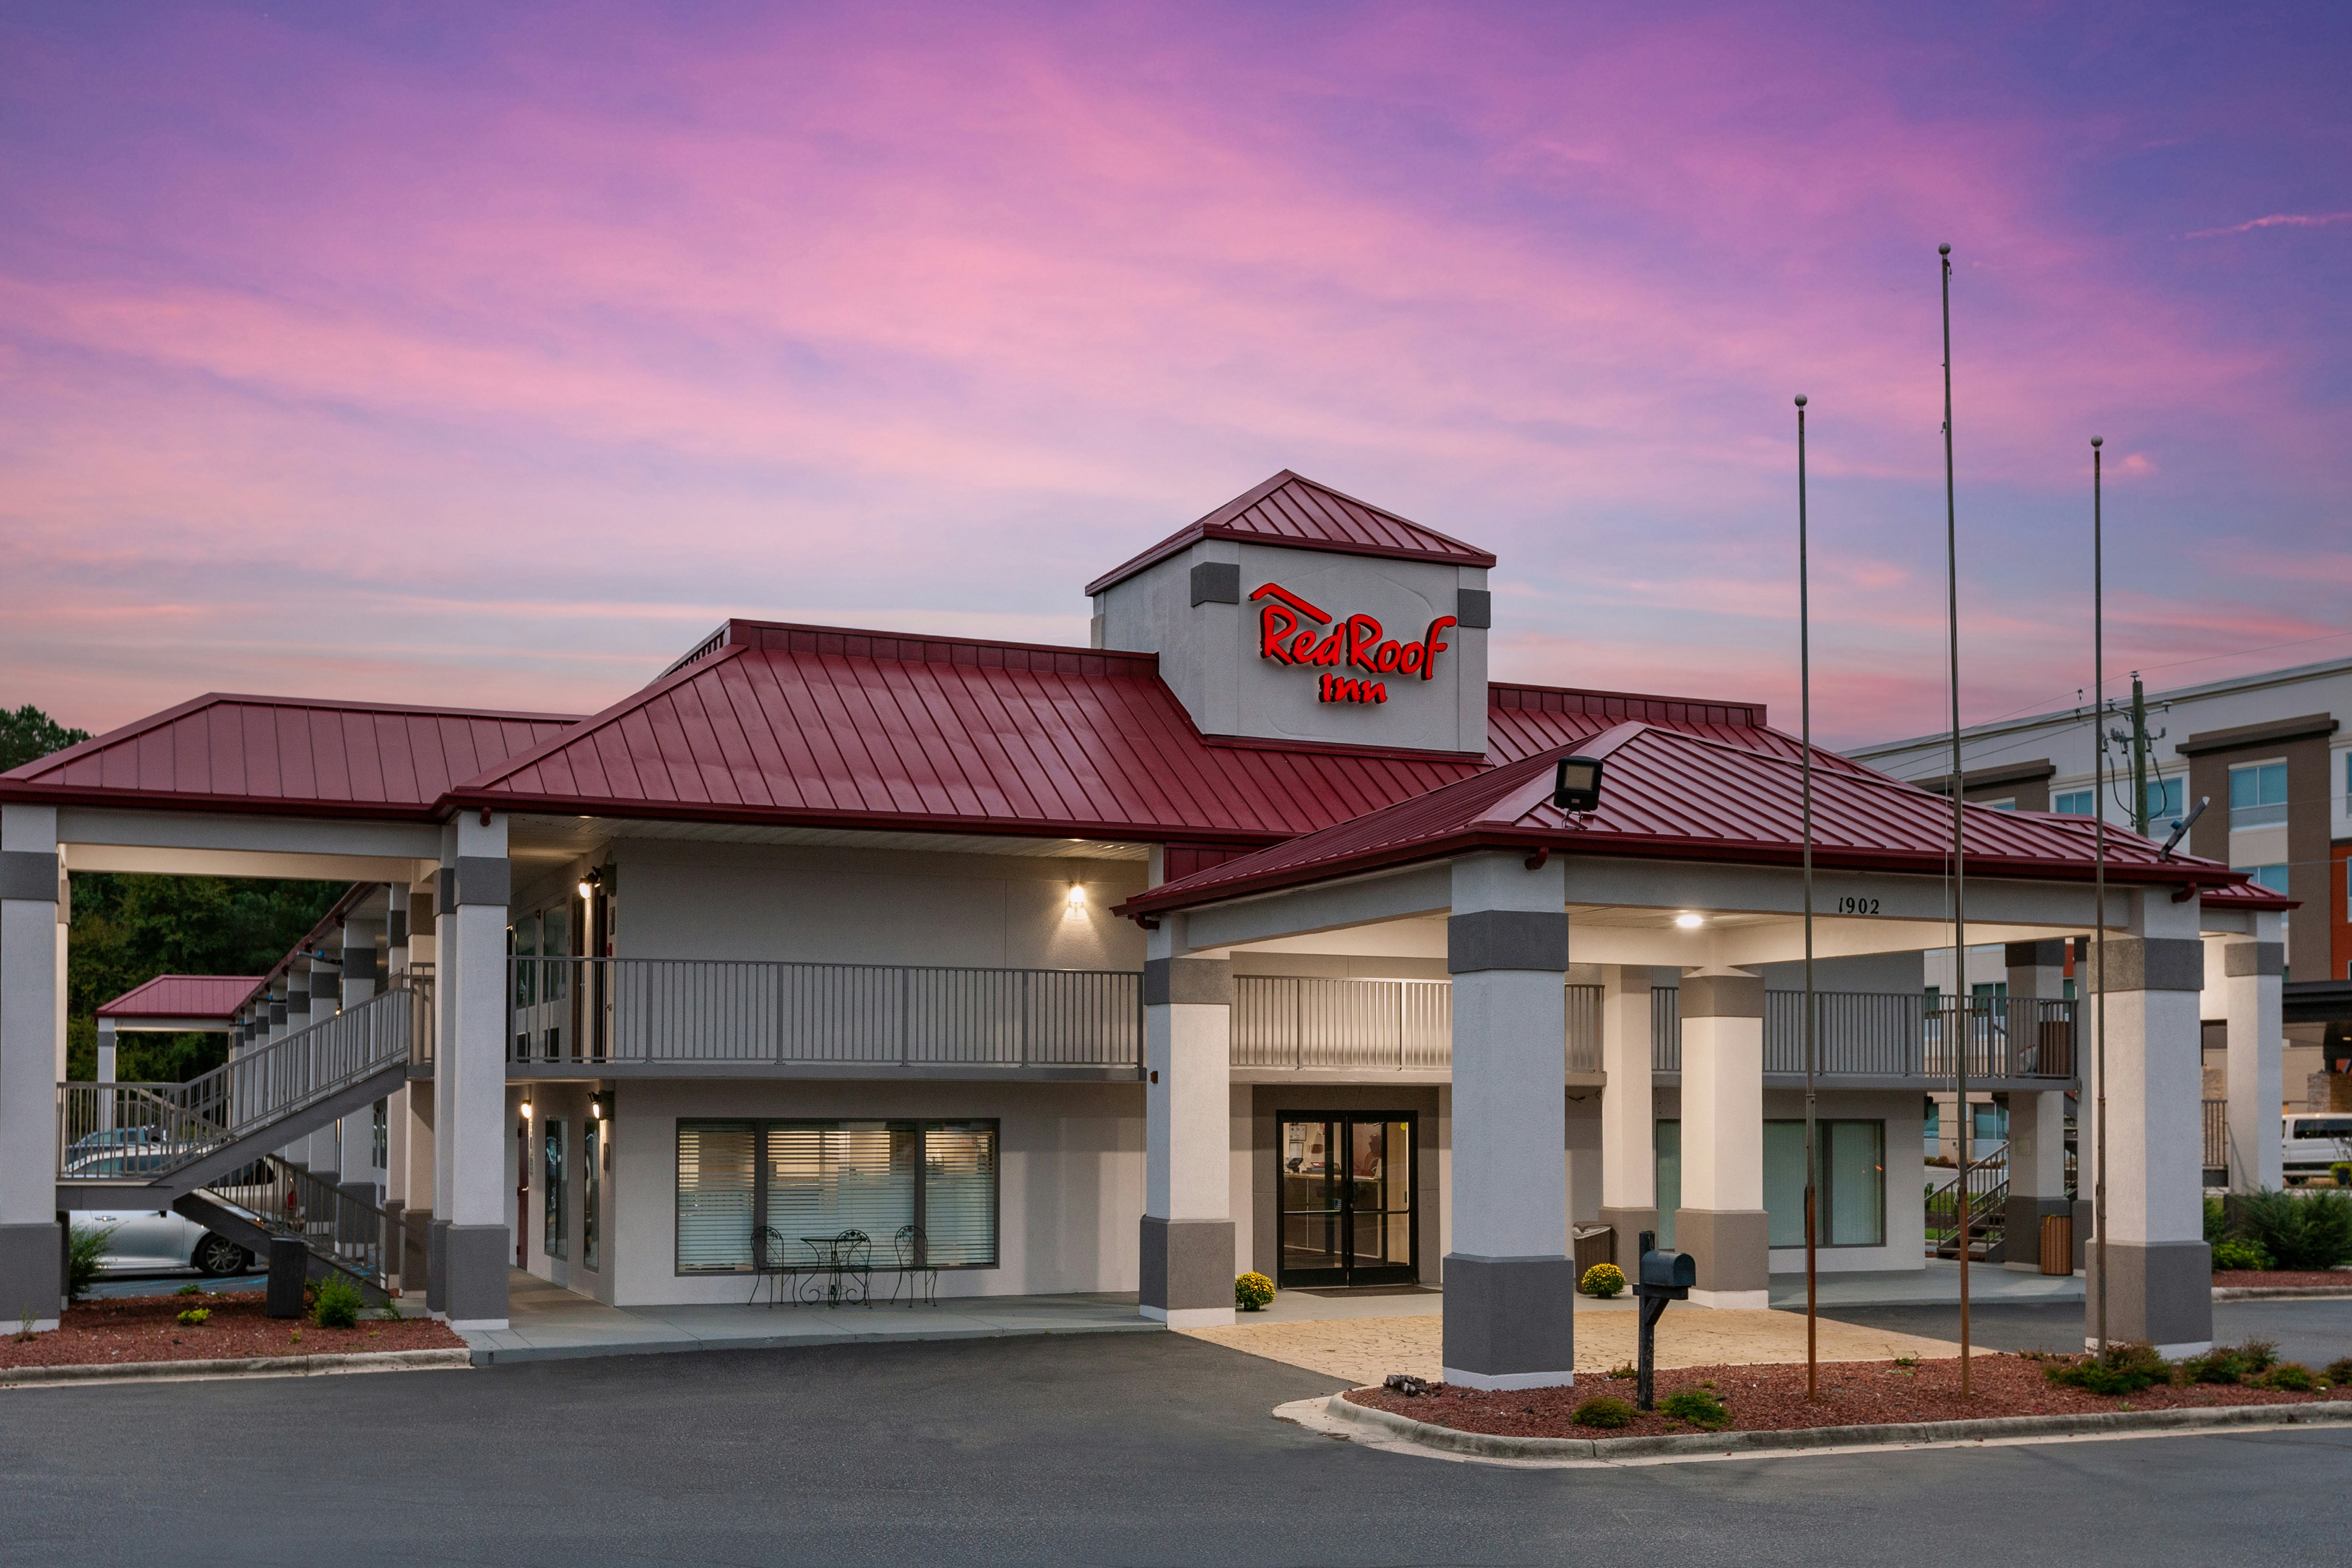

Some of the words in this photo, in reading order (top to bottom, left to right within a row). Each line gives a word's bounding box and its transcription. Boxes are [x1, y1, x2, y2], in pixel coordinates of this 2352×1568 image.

[1261, 605, 1346, 665] Red
[1347, 614, 1457, 680] Roof
[1839, 897, 1880, 915] 1902
